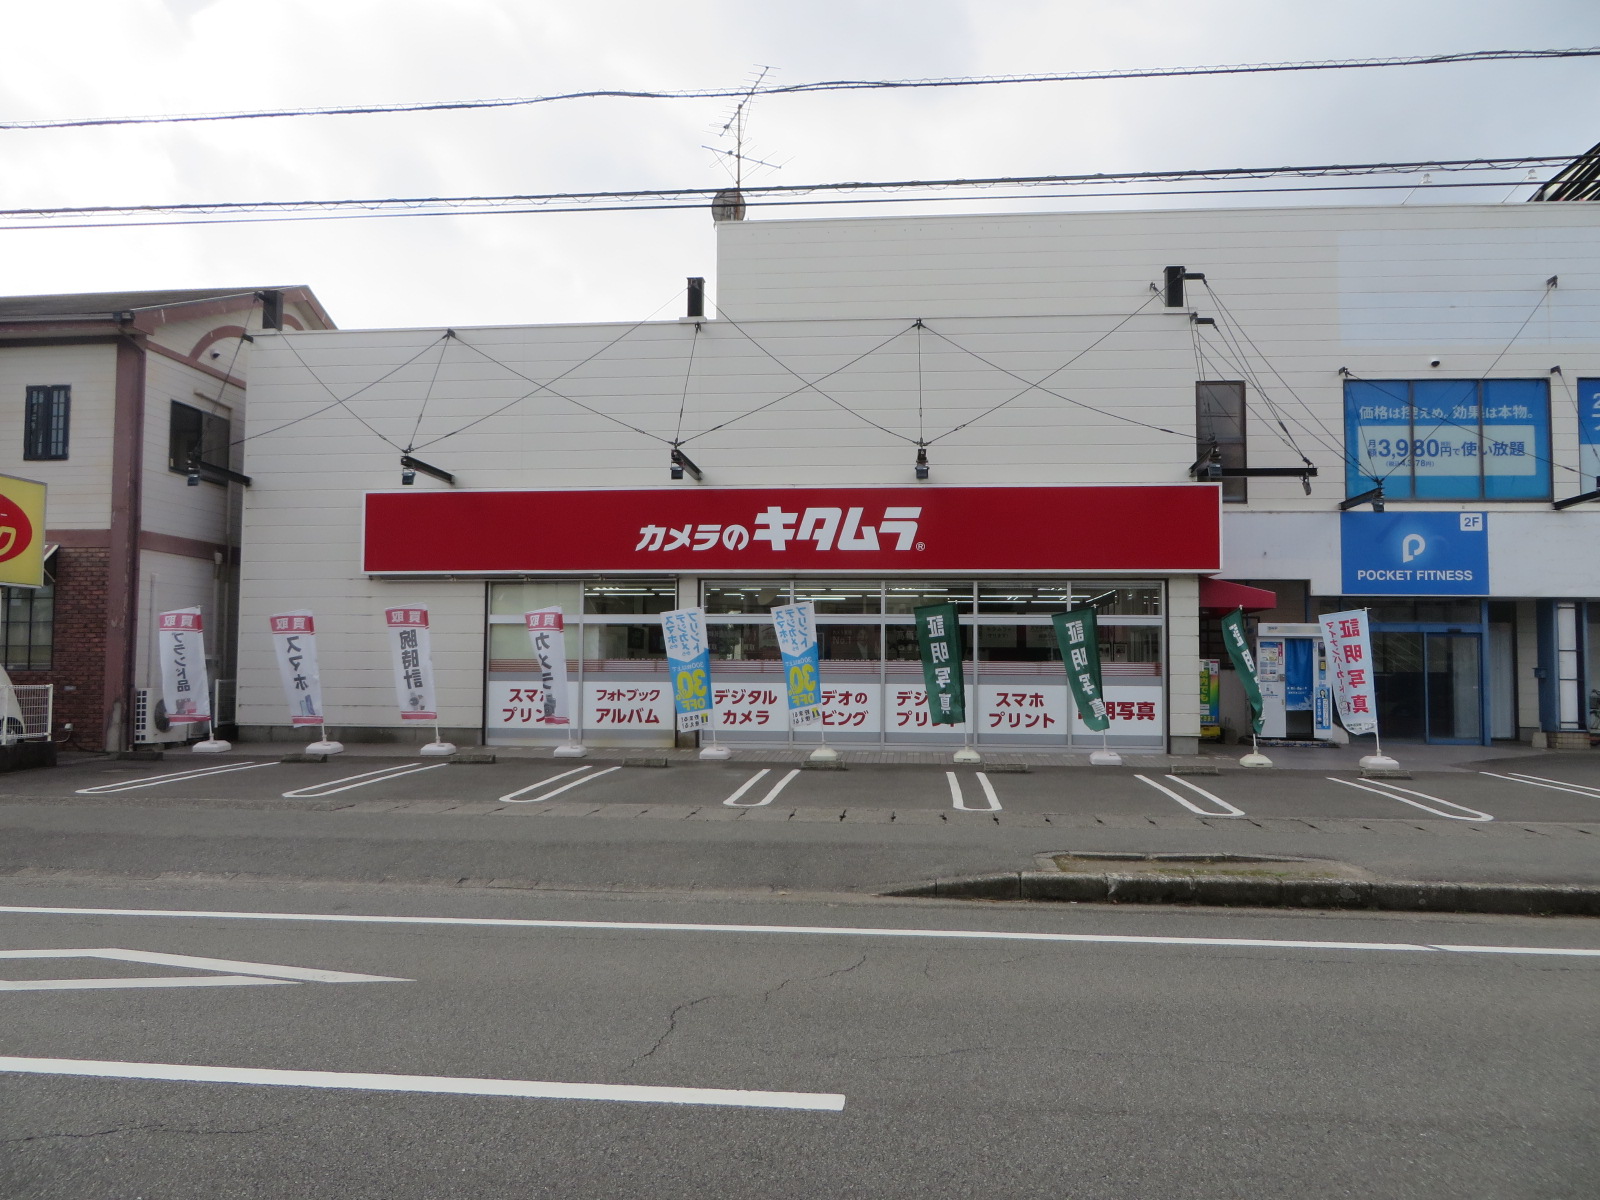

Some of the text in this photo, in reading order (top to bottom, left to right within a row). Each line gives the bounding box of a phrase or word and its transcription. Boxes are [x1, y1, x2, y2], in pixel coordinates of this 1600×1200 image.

[1464, 517, 1480, 527] 2F
[1357, 570, 1473, 581] POCKET FITNESS
[509, 689, 544, 702] スマ
[596, 689, 660, 702] フォトブック
[714, 688, 778, 705] デジタル
[996, 692, 1044, 708] スマホ
[596, 707, 660, 724] アルバム
[722, 709, 770, 725] カメラ
[988, 710, 1056, 728] プリント
